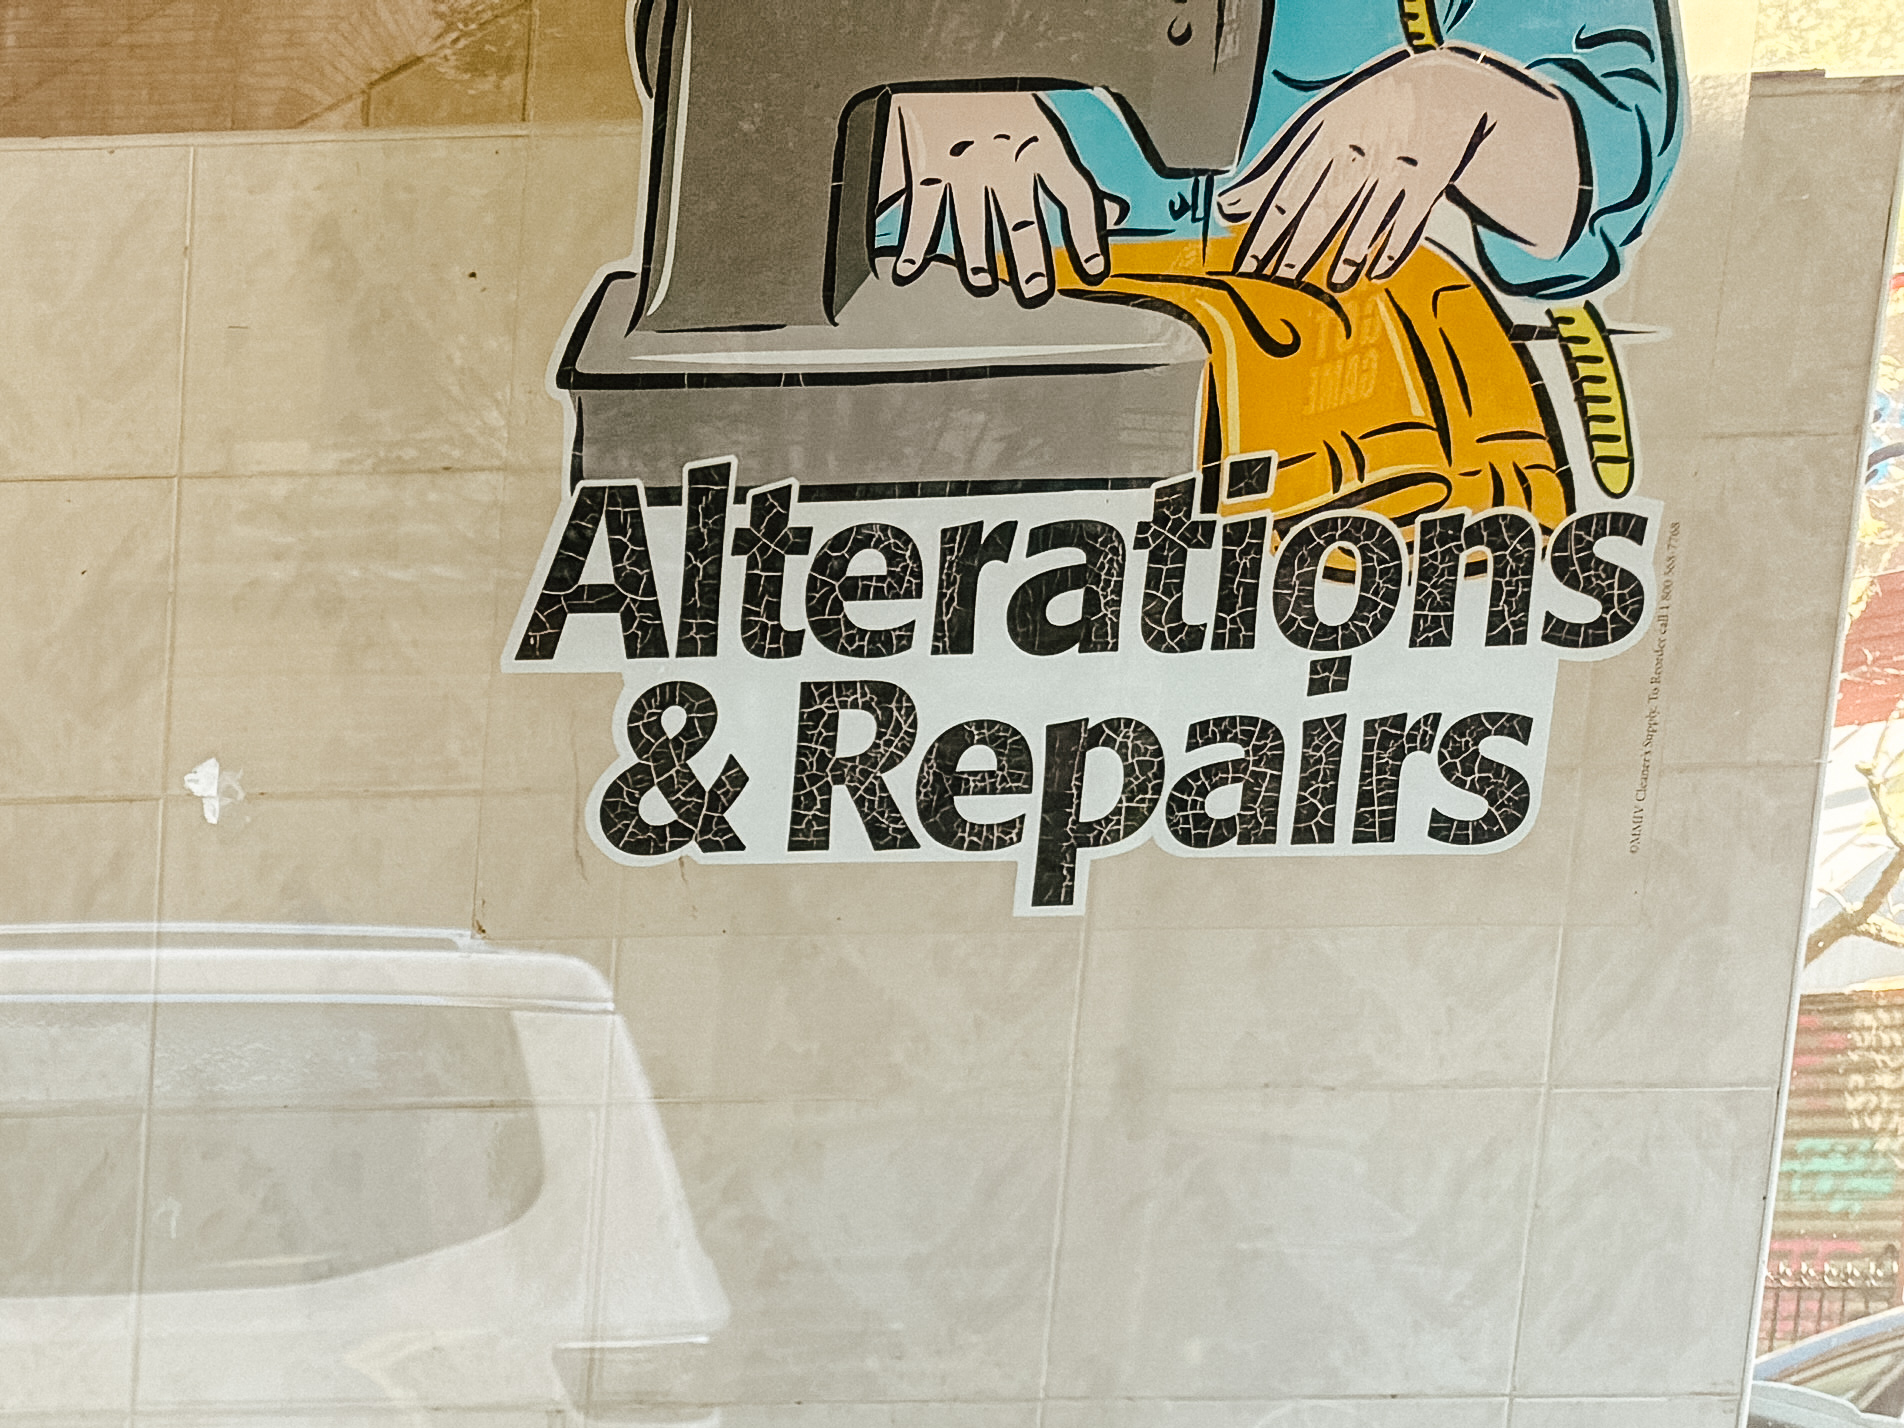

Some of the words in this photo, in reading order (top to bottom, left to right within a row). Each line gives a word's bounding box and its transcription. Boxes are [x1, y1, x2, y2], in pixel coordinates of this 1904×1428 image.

[516, 458, 1656, 662] Alterations
[598, 680, 750, 857] &
[787, 658, 1535, 907] Repairs
[1635, 750, 1653, 802] Cleaner's
[1649, 638, 1667, 684] Reorder
